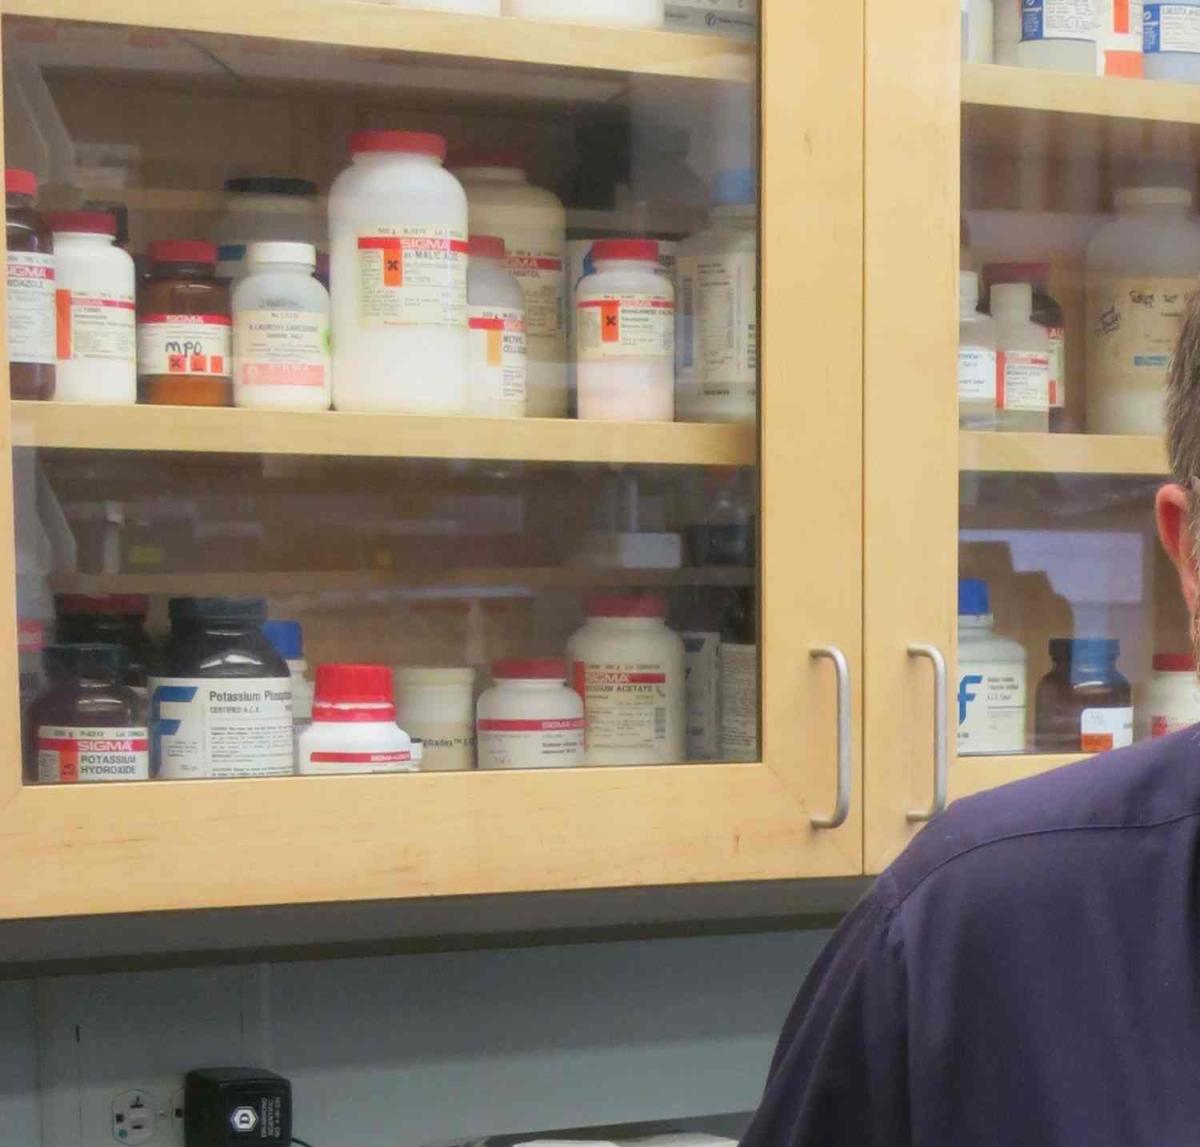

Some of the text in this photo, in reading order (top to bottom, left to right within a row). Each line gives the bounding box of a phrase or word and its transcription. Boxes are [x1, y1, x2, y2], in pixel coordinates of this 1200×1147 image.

[400, 239, 449, 251] SIGMA
[209, 690, 261, 702] Potassium
[78, 740, 132, 752] SIGMA
[80, 754, 136, 764] POTASSIUM
[80, 765, 136, 775] HYDROXIDE
